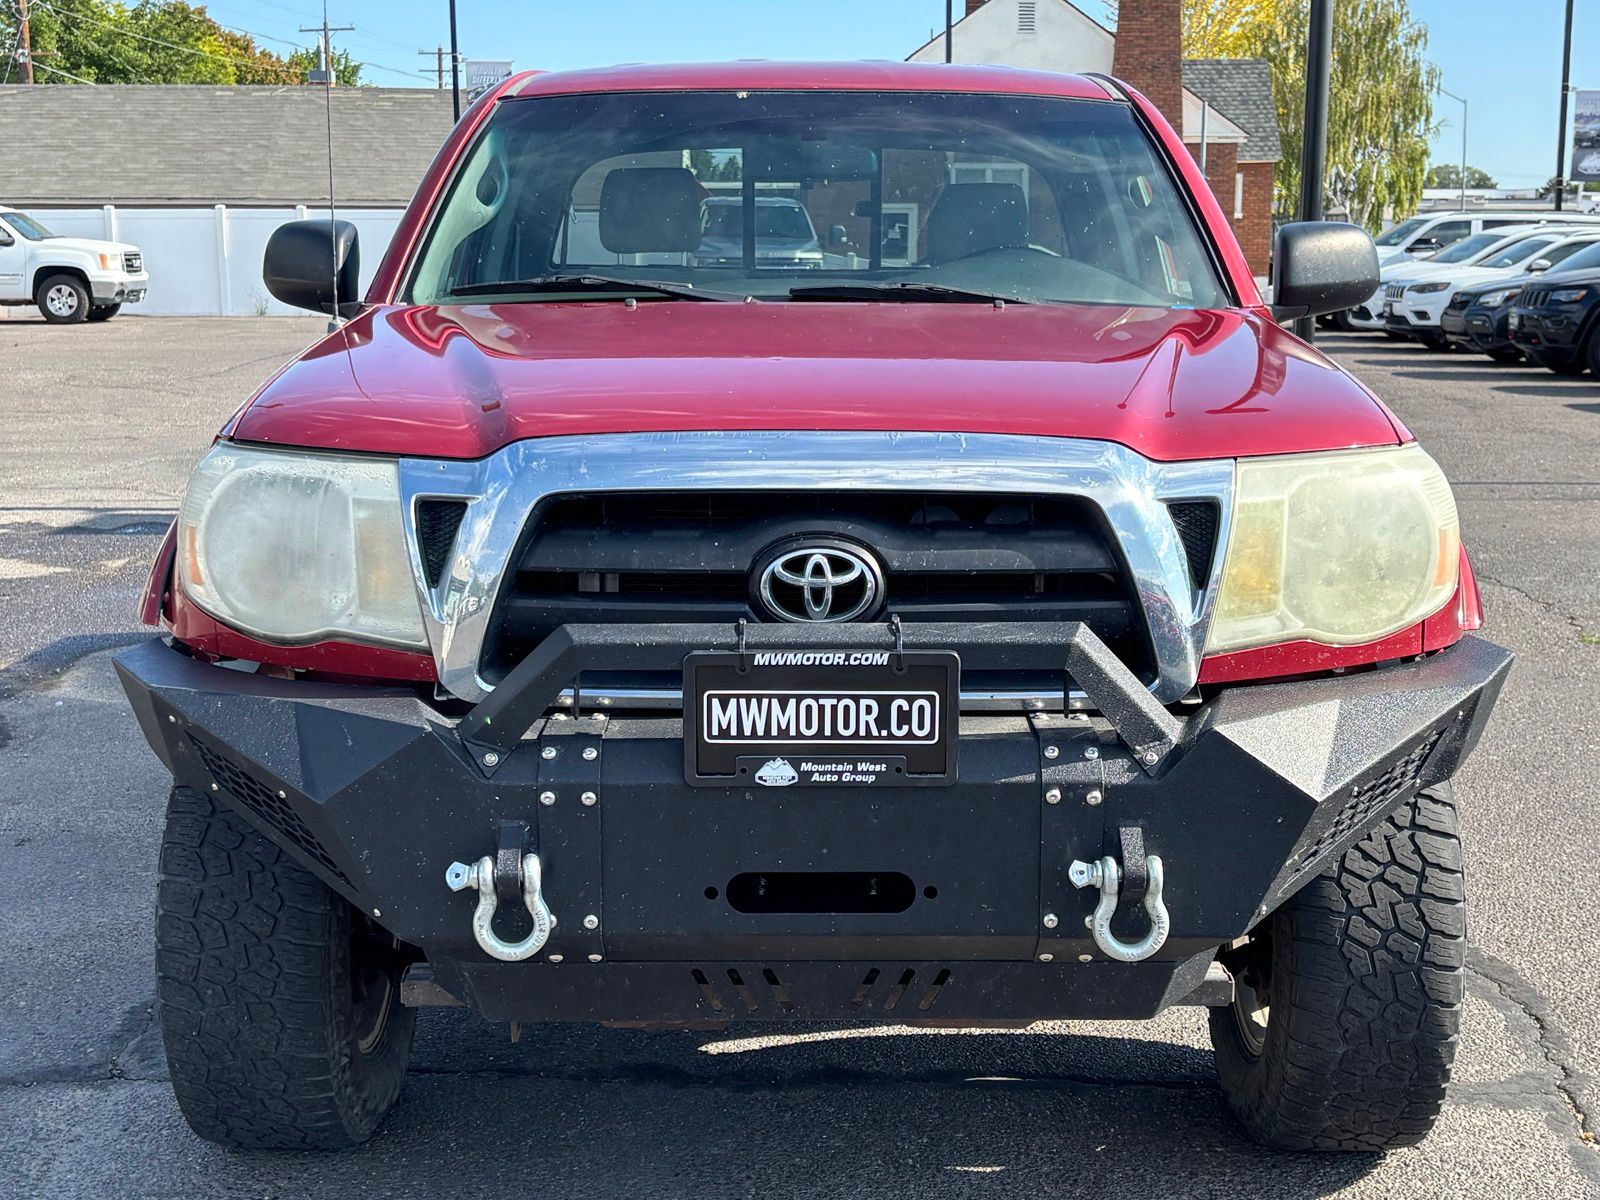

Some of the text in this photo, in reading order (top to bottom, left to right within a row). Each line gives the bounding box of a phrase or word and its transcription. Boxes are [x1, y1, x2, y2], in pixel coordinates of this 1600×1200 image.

[753, 653, 890, 666] MWMOTOR.COM
[711, 698, 932, 737] MWMOTOR.CO
[800, 762, 887, 772] Mountain West
[811, 772, 876, 784] Auto Group
